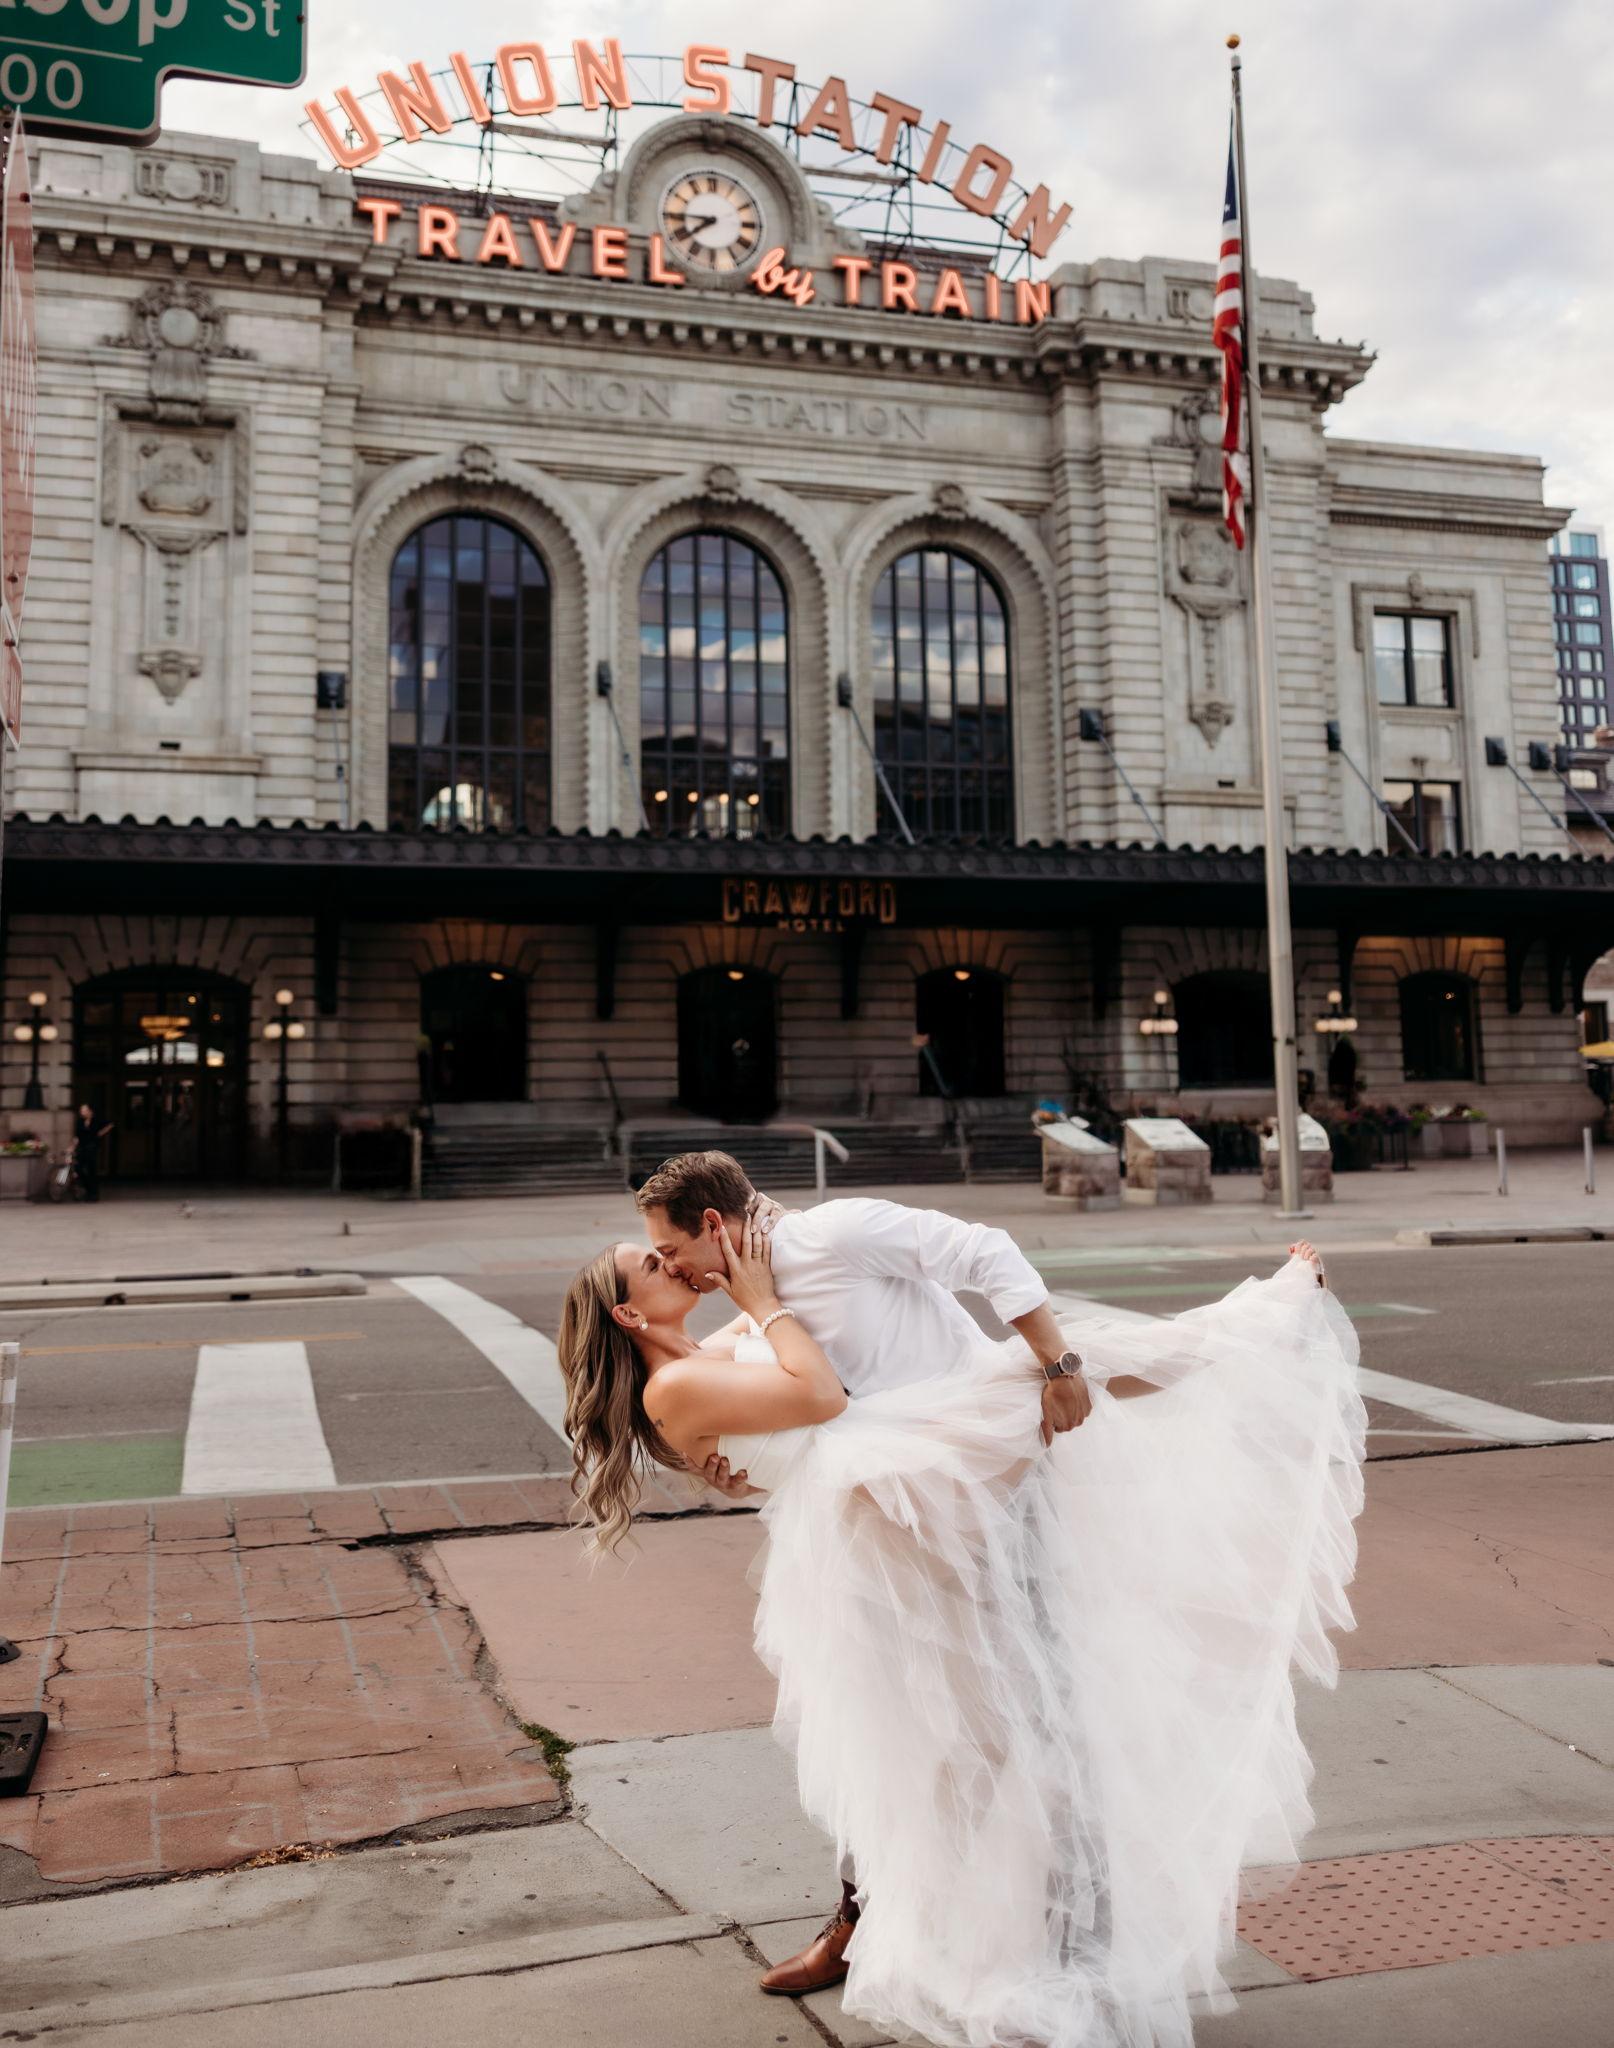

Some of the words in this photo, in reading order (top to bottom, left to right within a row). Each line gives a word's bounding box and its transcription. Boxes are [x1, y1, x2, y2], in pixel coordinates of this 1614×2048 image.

[223, 0, 281, 37] St
[0, 53, 83, 110] 00
[304, 38, 633, 169] UNION
[683, 44, 1074, 259] STATION
[357, 197, 687, 286] TRAVEL
[750, 247, 816, 307] by
[833, 255, 1052, 325] TRAIN
[497, 369, 678, 418] UNION
[726, 393, 930, 441] STATION
[722, 879, 897, 924] CRAWFORD
[778, 919, 845, 932] HOTEL
